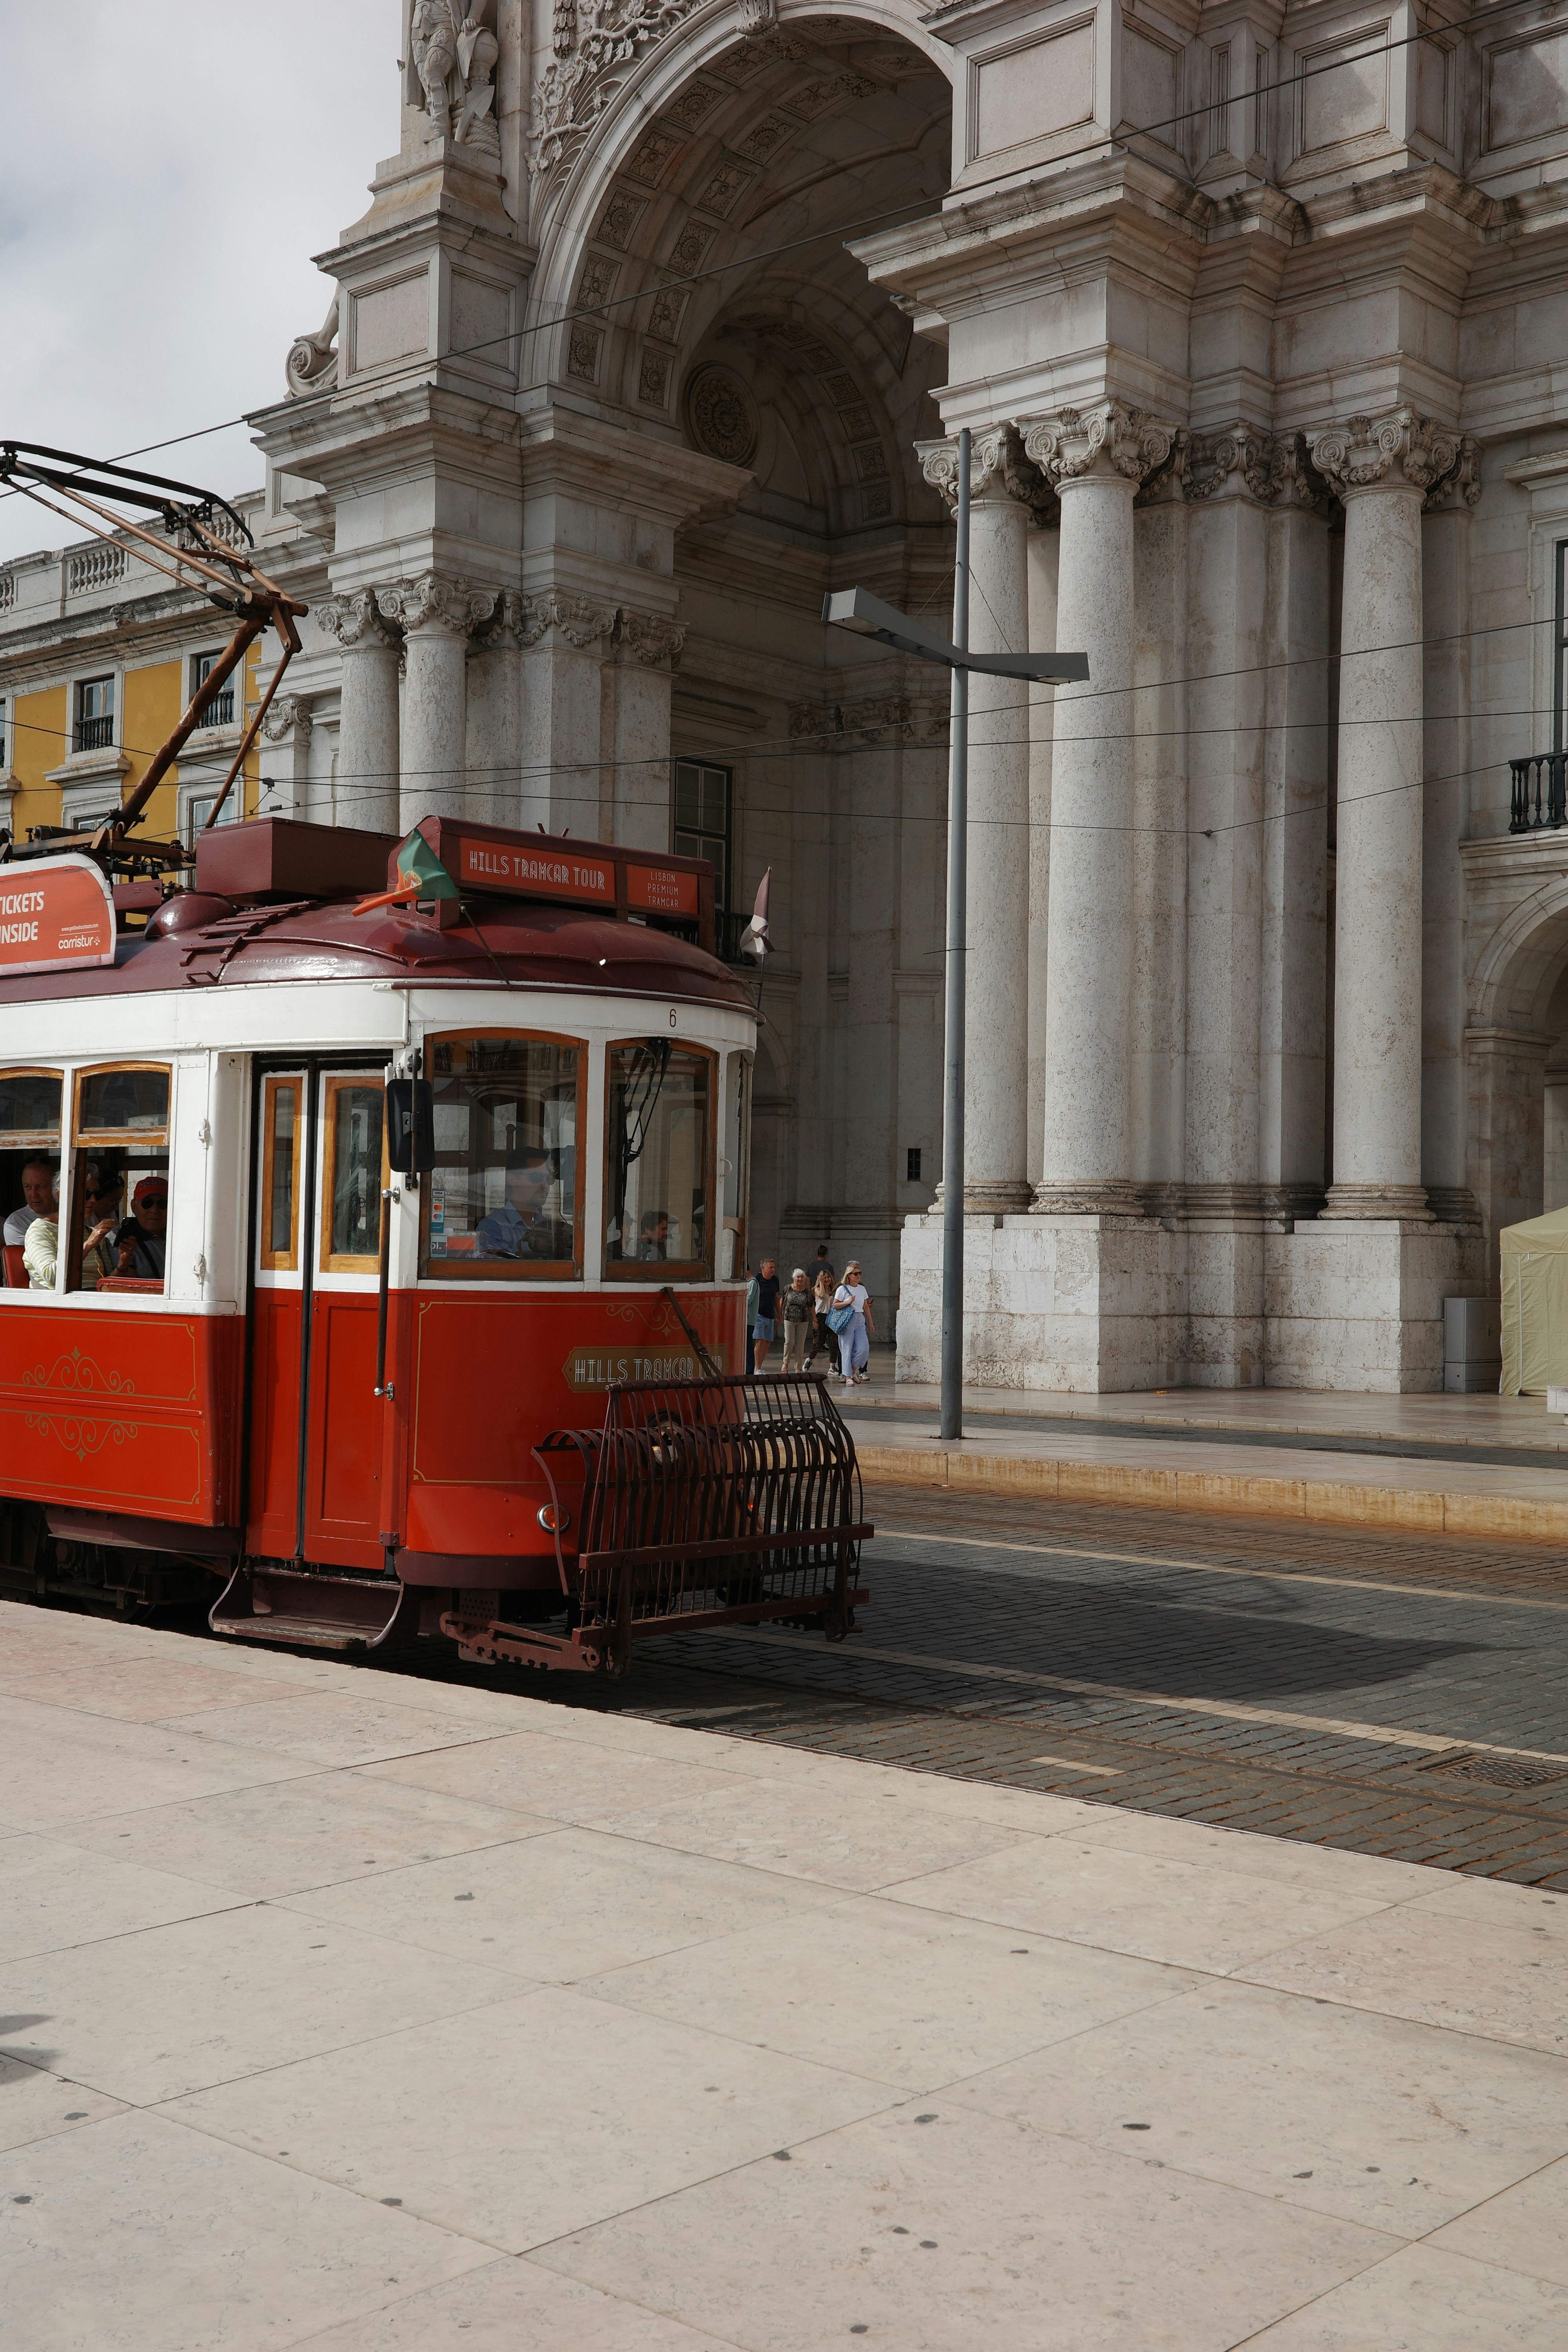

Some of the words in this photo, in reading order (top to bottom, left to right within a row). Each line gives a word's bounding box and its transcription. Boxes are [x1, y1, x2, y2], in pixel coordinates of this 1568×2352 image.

[470, 850, 509, 875] HILLS
[513, 857, 569, 884] TRAMCAR
[573, 867, 605, 890] TOUR
[651, 871, 675, 883] LISBON
[648, 883, 678, 896] PREMIUM
[648, 896, 678, 908] TRAMCAR
[58, 935, 94, 949] carristur
[670, 1008, 677, 1027] 6
[575, 1359, 628, 1383] HILLS
[633, 1357, 693, 1380] TRAMCAR
